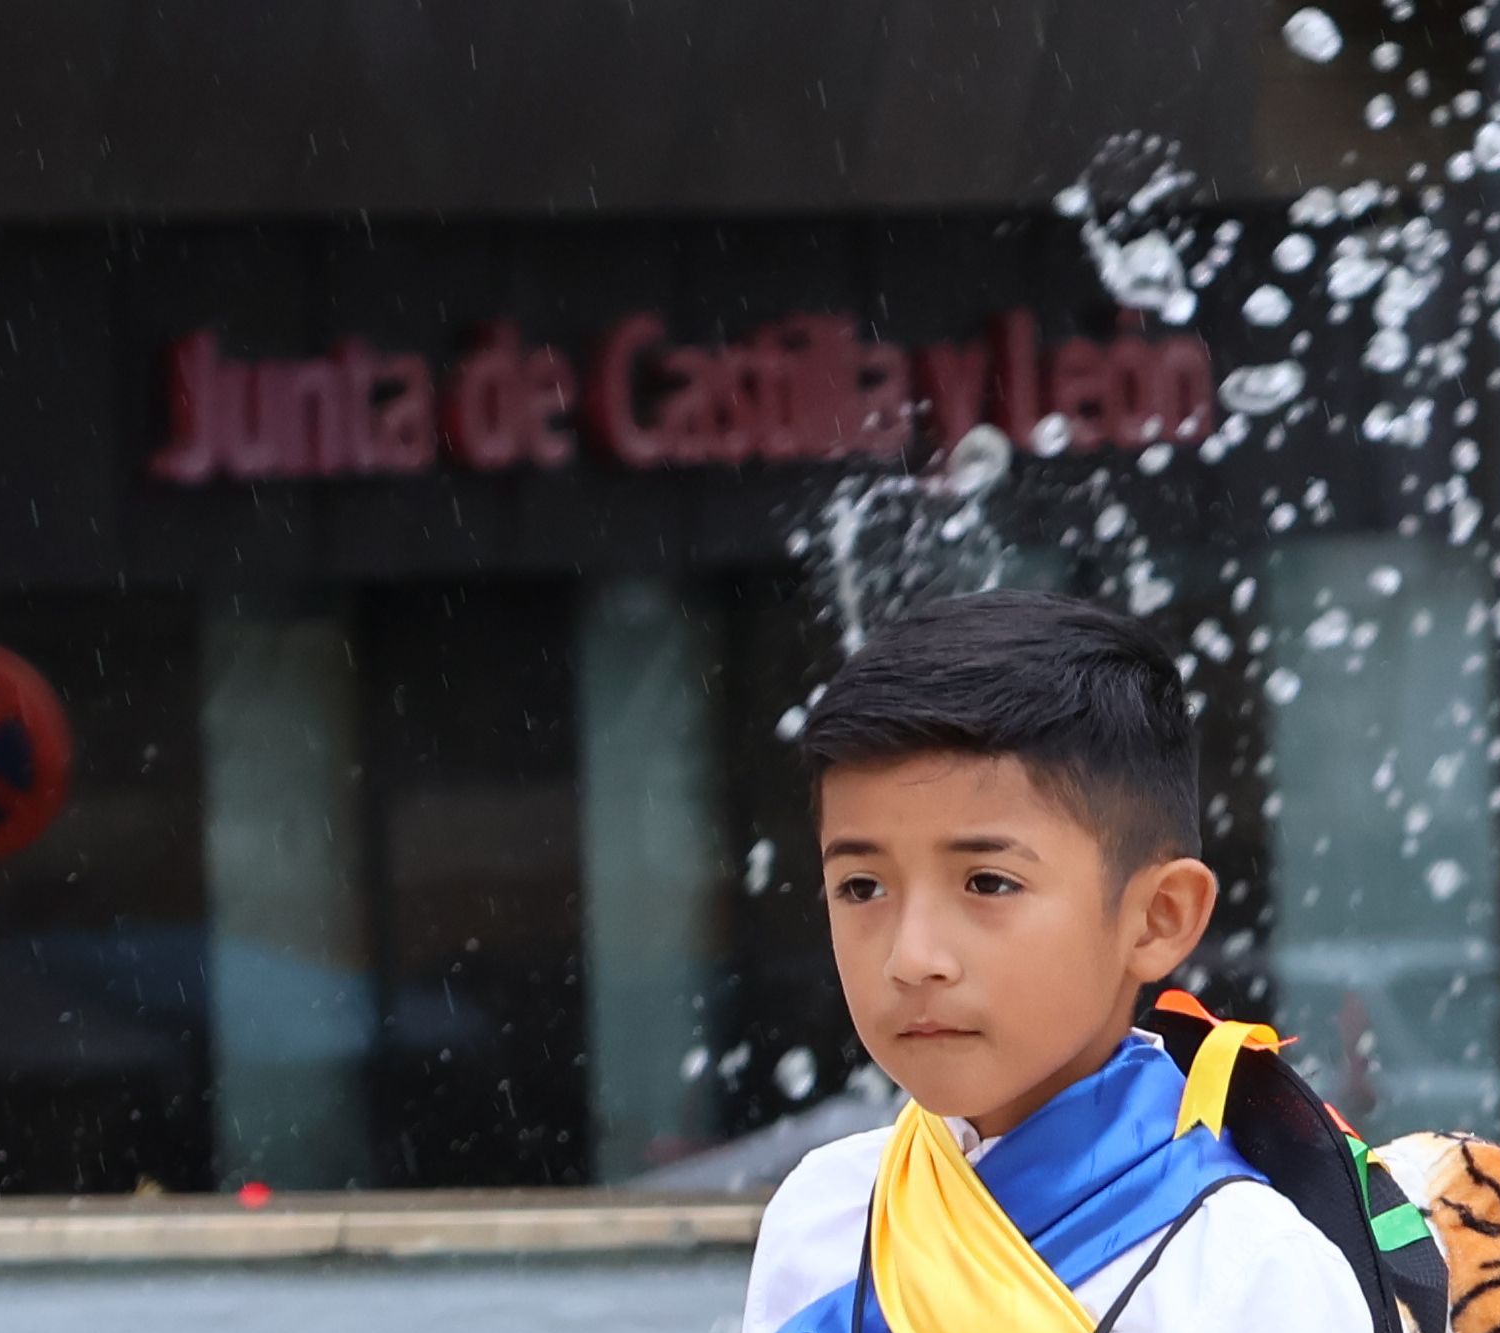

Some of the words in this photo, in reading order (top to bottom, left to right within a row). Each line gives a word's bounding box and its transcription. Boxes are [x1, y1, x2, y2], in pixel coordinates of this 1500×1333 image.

[154, 330, 436, 482] Junta
[450, 320, 572, 468] de
[595, 312, 910, 466] Castilla
[918, 340, 995, 496] y
